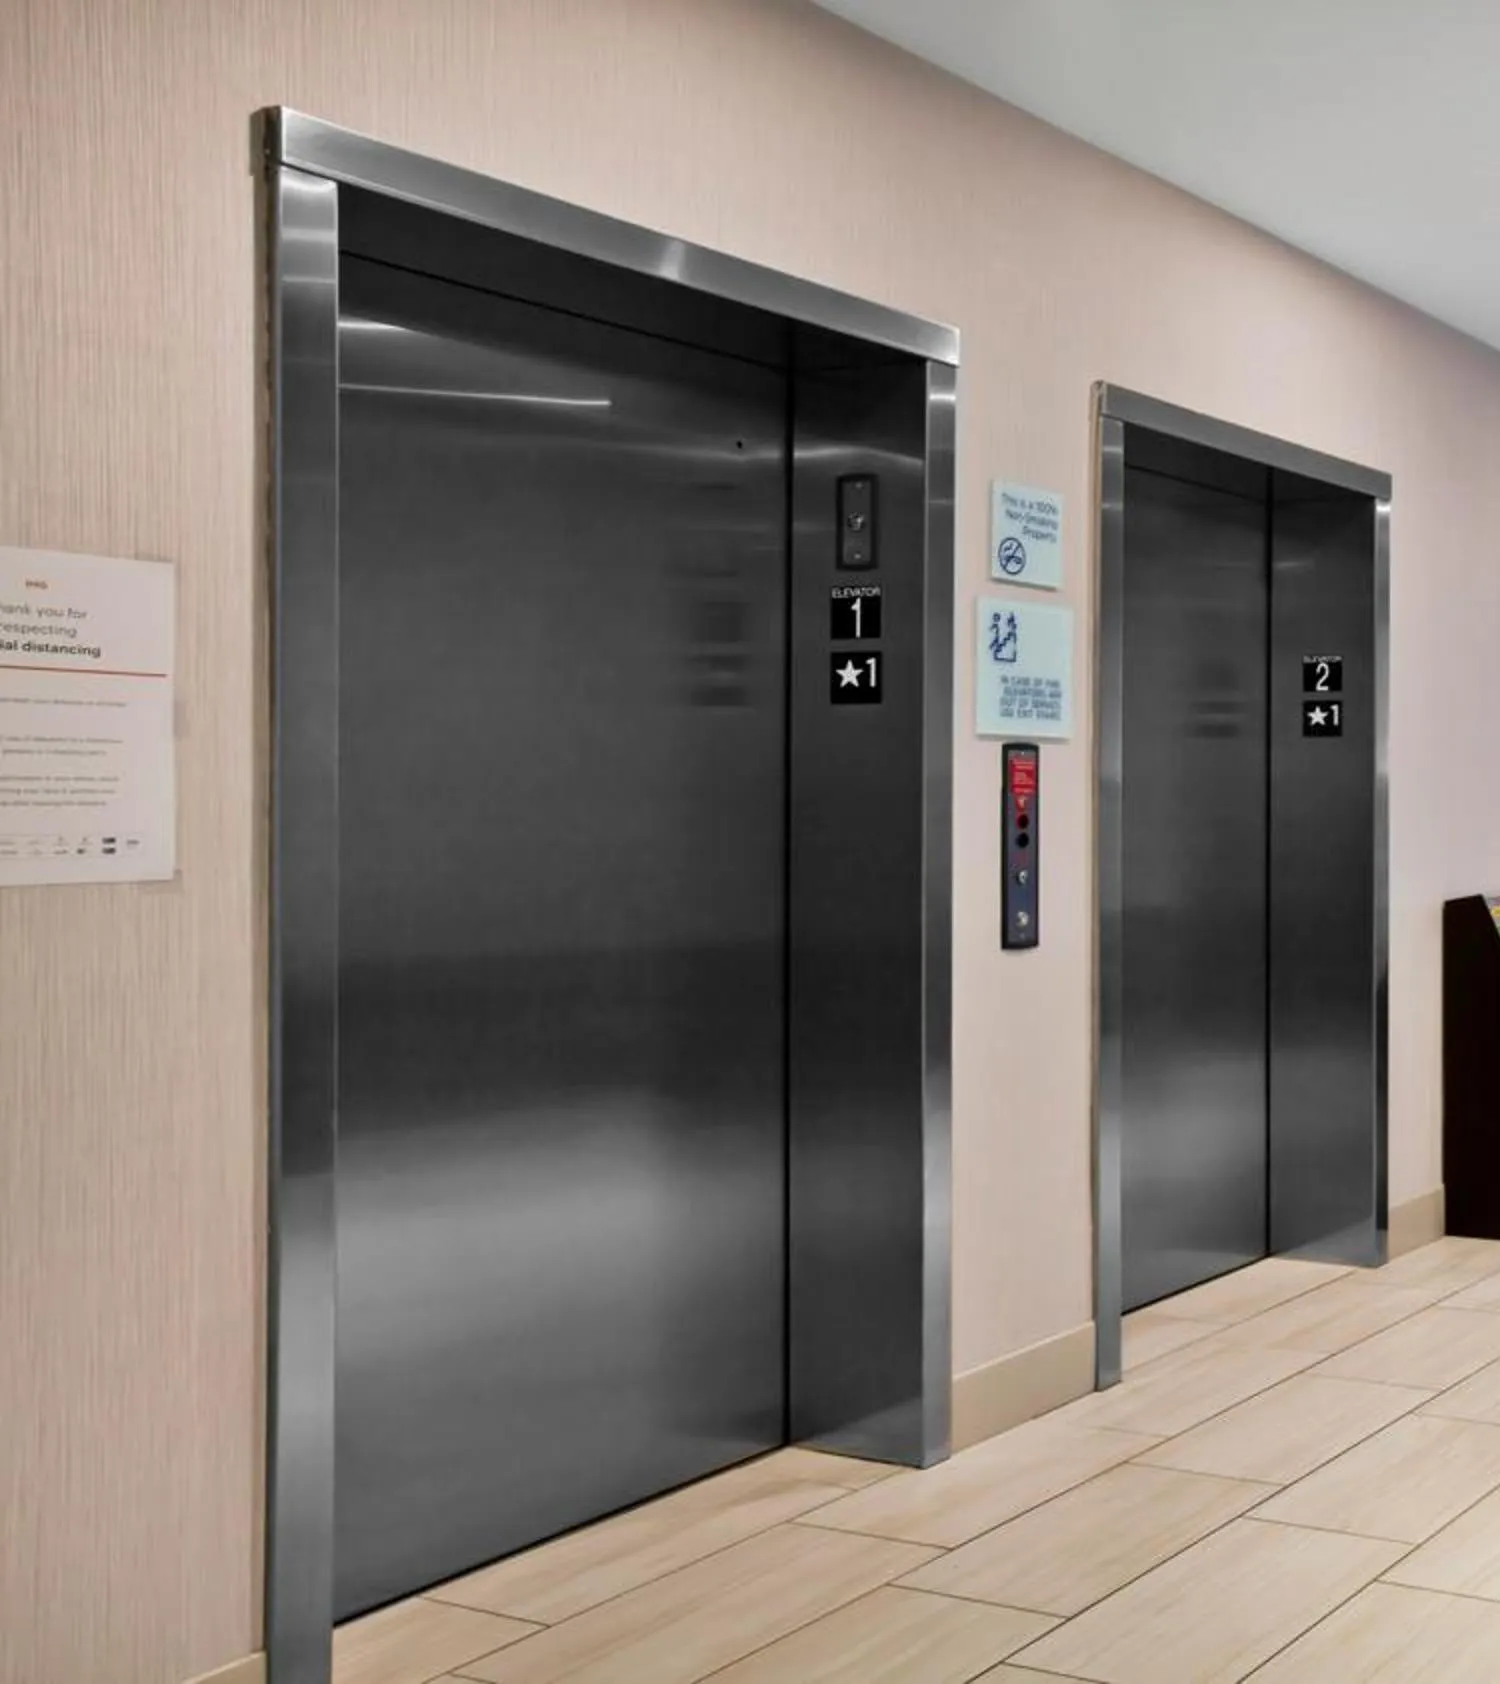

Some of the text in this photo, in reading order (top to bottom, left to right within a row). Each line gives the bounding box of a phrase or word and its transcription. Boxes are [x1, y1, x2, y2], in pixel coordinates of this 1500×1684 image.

[832, 587, 880, 598] ELEVATOR
[0, 600, 88, 619] hank you for
[851, 597, 862, 638] 1
[0, 622, 78, 639] especting
[21, 640, 101, 659] distancing
[866, 657, 876, 687] 1
[1316, 662, 1329, 691] 2
[1330, 704, 1339, 725] 1
